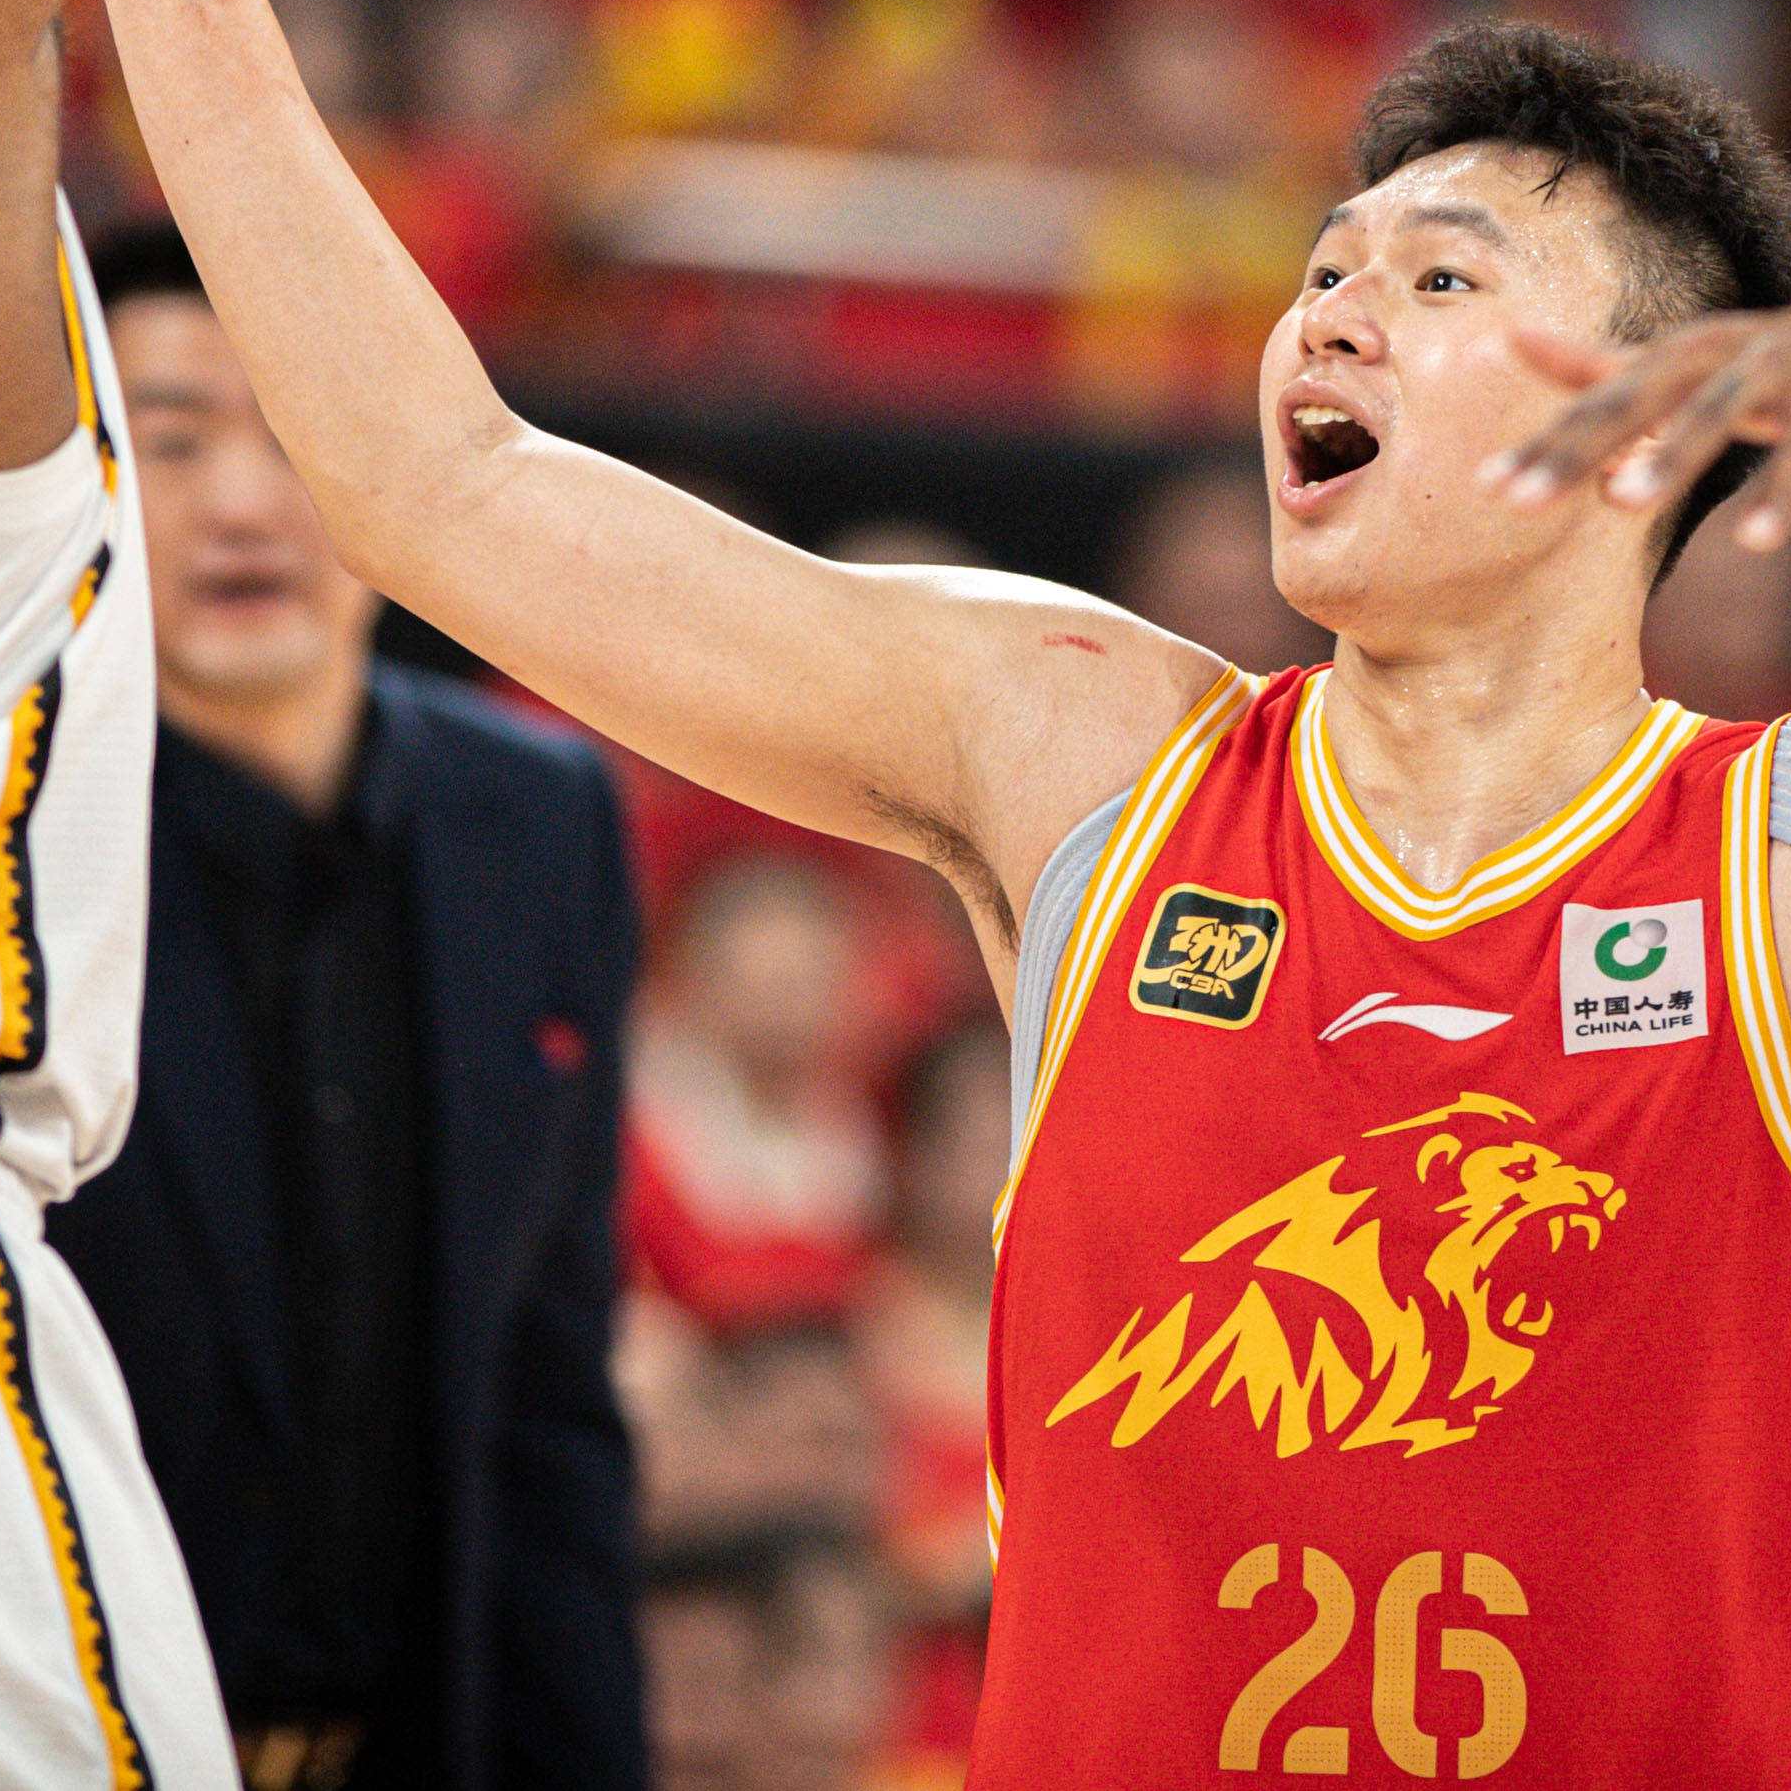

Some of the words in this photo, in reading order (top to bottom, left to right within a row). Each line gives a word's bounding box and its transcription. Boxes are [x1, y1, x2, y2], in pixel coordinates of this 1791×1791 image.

[1169, 973, 1235, 1000] CBA
[1574, 990, 1694, 1020] 中国人寿
[1575, 1020, 1642, 1036] CHINA
[1650, 1014, 1694, 1031] LIFE
[1217, 1542, 1529, 1780] 26
